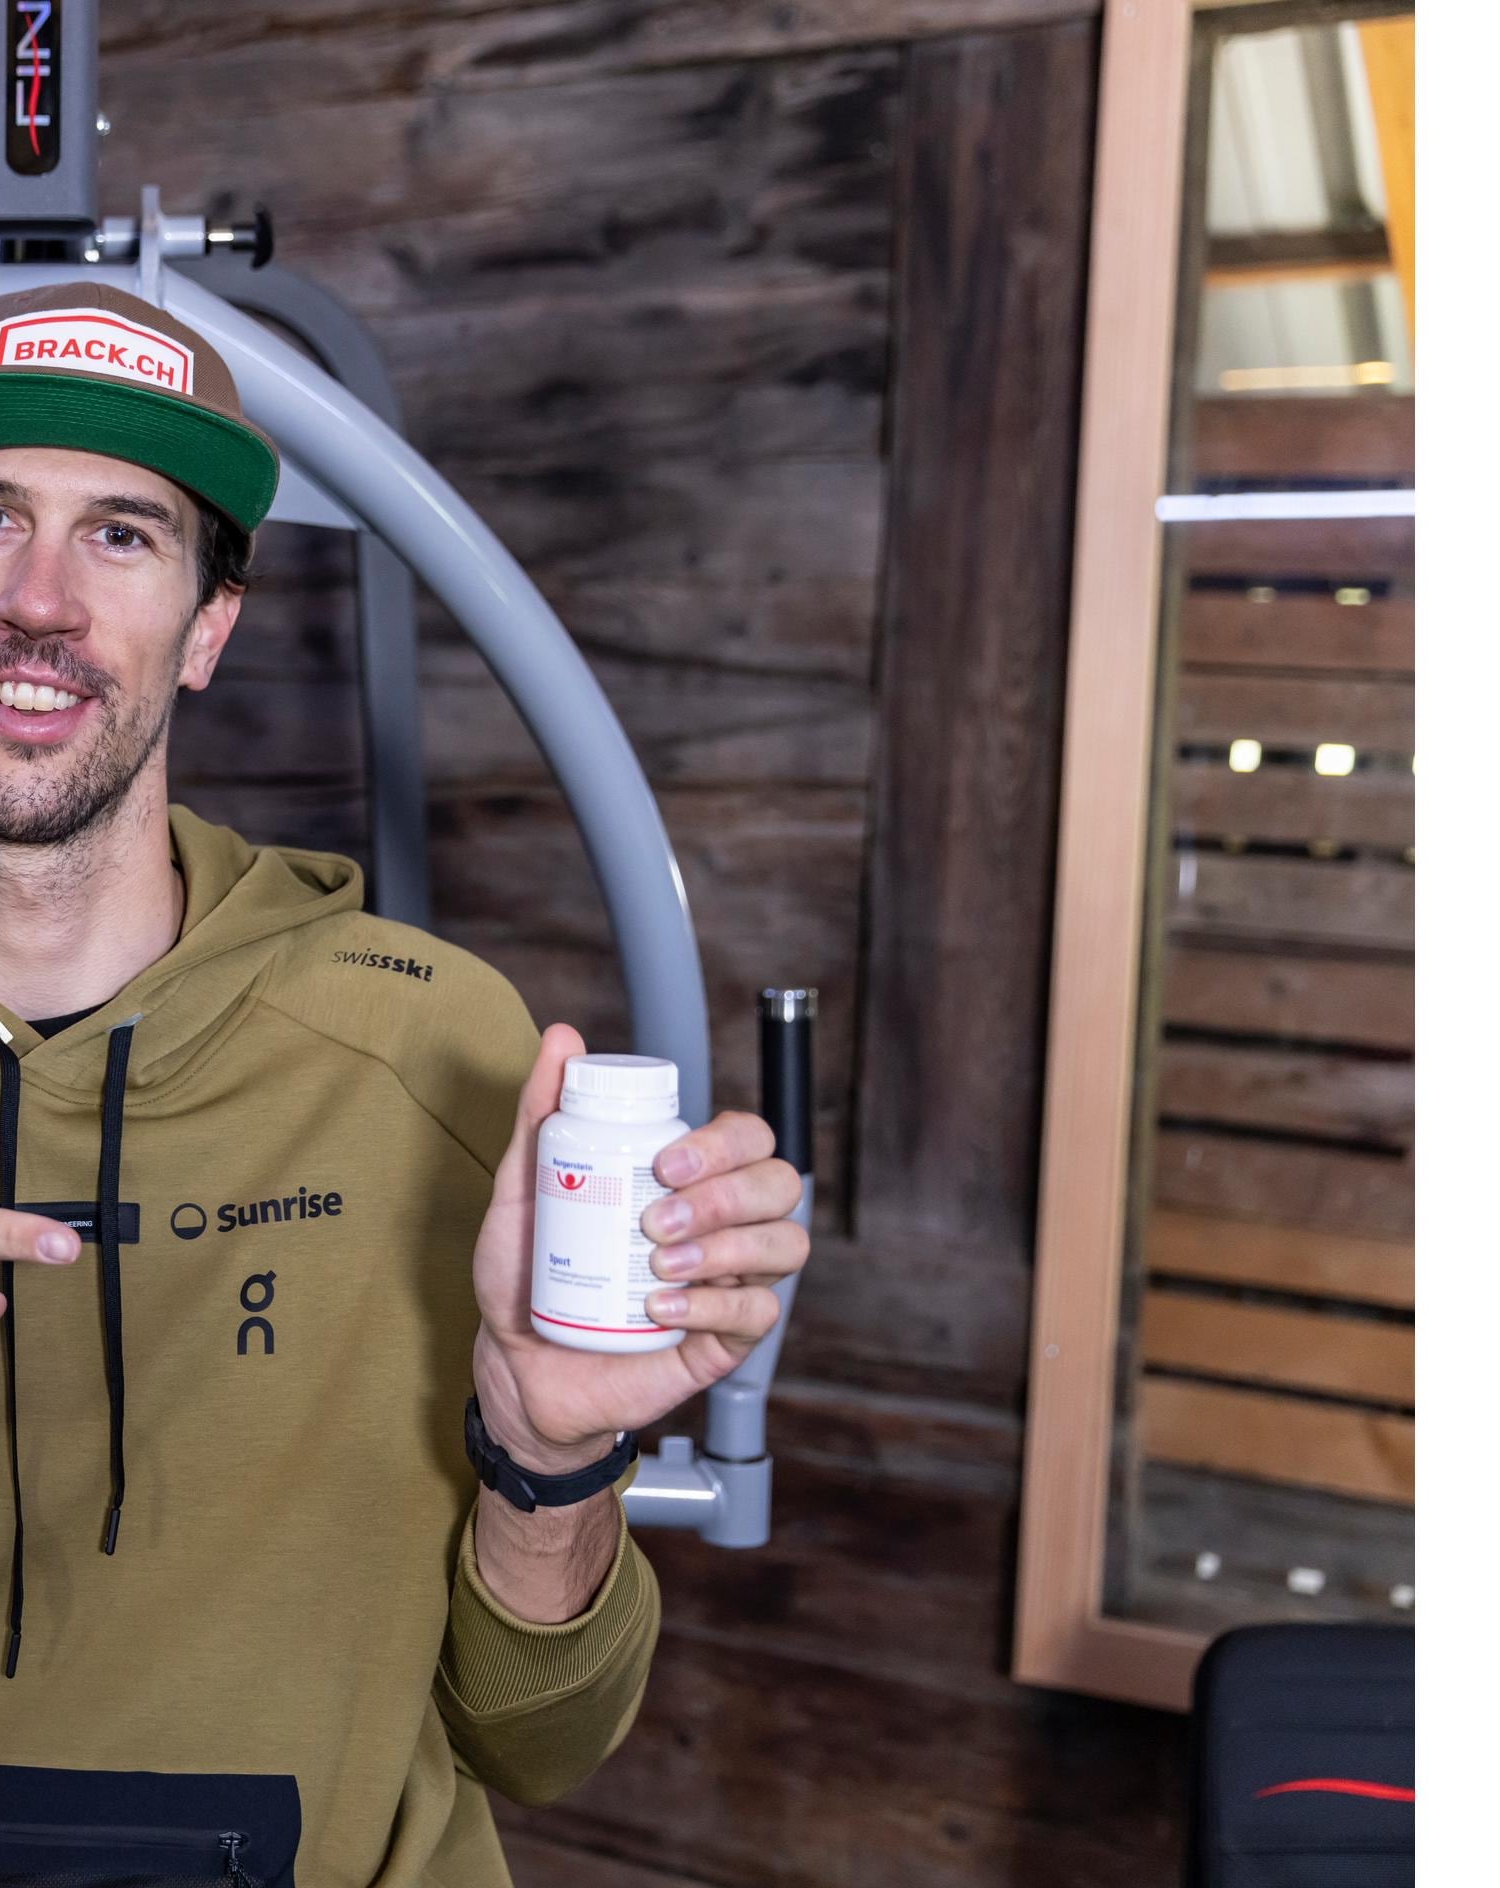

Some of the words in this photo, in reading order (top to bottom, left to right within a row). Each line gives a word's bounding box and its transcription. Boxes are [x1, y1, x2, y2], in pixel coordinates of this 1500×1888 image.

[14, 338, 175, 387] BRACK.CH
[331, 948, 433, 982] swissski
[217, 1186, 343, 1232] Sunrise
[549, 1253, 570, 1267] Sport
